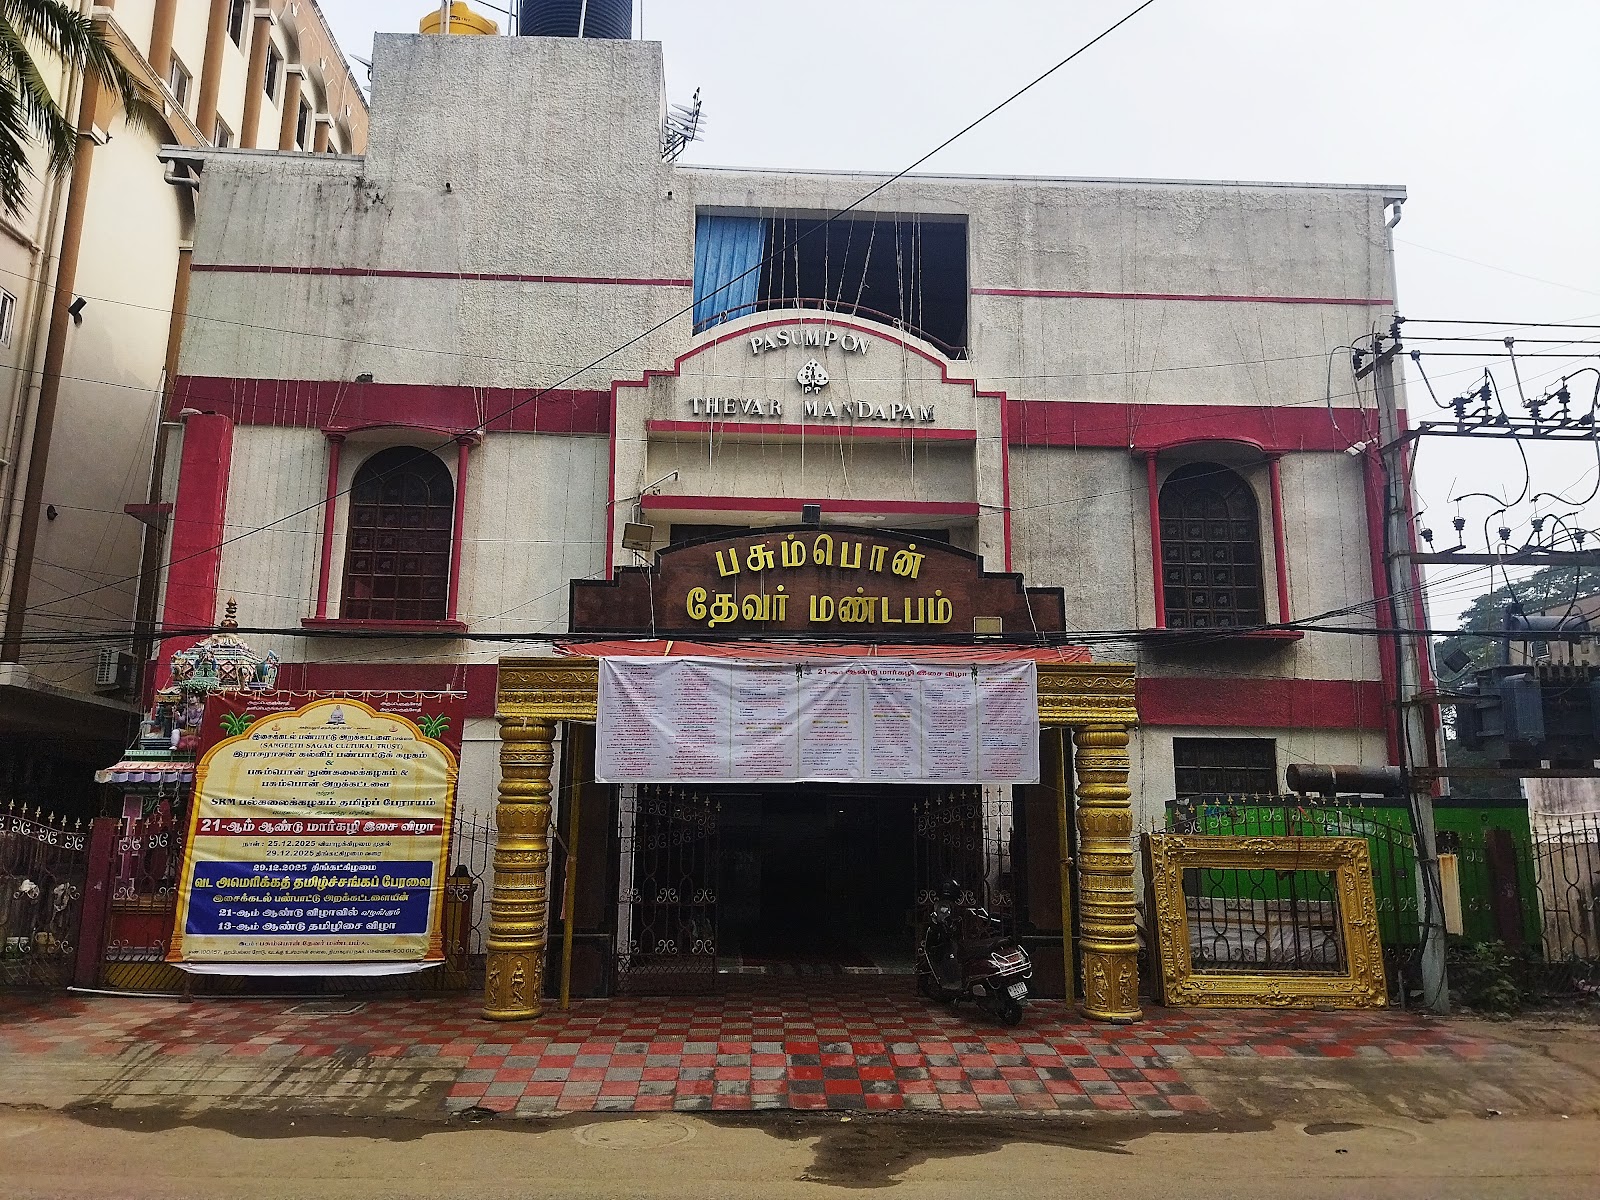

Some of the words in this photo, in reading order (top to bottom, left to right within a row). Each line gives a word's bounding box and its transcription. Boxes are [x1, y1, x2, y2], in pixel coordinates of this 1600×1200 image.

[749, 329, 871, 355] PASUMPON
[690, 397, 782, 415] THEVAR
[803, 400, 935, 422] MANDAPAM
[715, 533, 925, 578] பசும்பொன்
[686, 585, 789, 628] தேவர்
[809, 587, 953, 624] மண்டபம்
[879, 669, 915, 677] மார்கழி
[252, 731, 296, 741] இசைக்கடல்
[298, 731, 337, 742] பண்பாட்டு
[338, 732, 392, 742] அறக்கட்டளை
[233, 750, 296, 759] இராசராசன்
[298, 750, 333, 758] கல்விப்
[336, 750, 393, 759] பண்பாட்டுக்
[395, 751, 428, 760] கழகம்
[211, 798, 236, 806] SRM
[238, 796, 337, 808] பல்கலைக்கழகம்
[339, 797, 380, 808] தமிழ்ப்
[383, 797, 436, 808] பேராயம்
[201, 818, 255, 833] 21-ஆம்
[258, 819, 304, 834] ஆண்டு
[306, 819, 360, 835] மார்கழி
[363, 821, 398, 832] இசை
[400, 819, 435, 834] விழா
[252, 864, 307, 872] 29.12.2025
[310, 862, 377, 873] திங்கட்கிழமை
[194, 878, 213, 888] வட
[216, 875, 291, 891] அமெரிக்கத்
[292, 875, 379, 891] தமிழ்ச்சங்கப்
[381, 874, 431, 889] பேரவை
[212, 892, 272, 903] இசைக்கடல்
[274, 892, 321, 904] பண்பாட்டு
[323, 891, 410, 903] அறக்கட்டளையின்
[218, 908, 260, 917] 21-ஆம்
[262, 907, 304, 918] ஆண்டு
[306, 907, 359, 918] விழாவில்
[218, 921, 259, 931] 13-ஆம்
[262, 920, 306, 932] ஆண்டு
[307, 921, 363, 932] தமிழிசை
[365, 920, 397, 932] விழா
